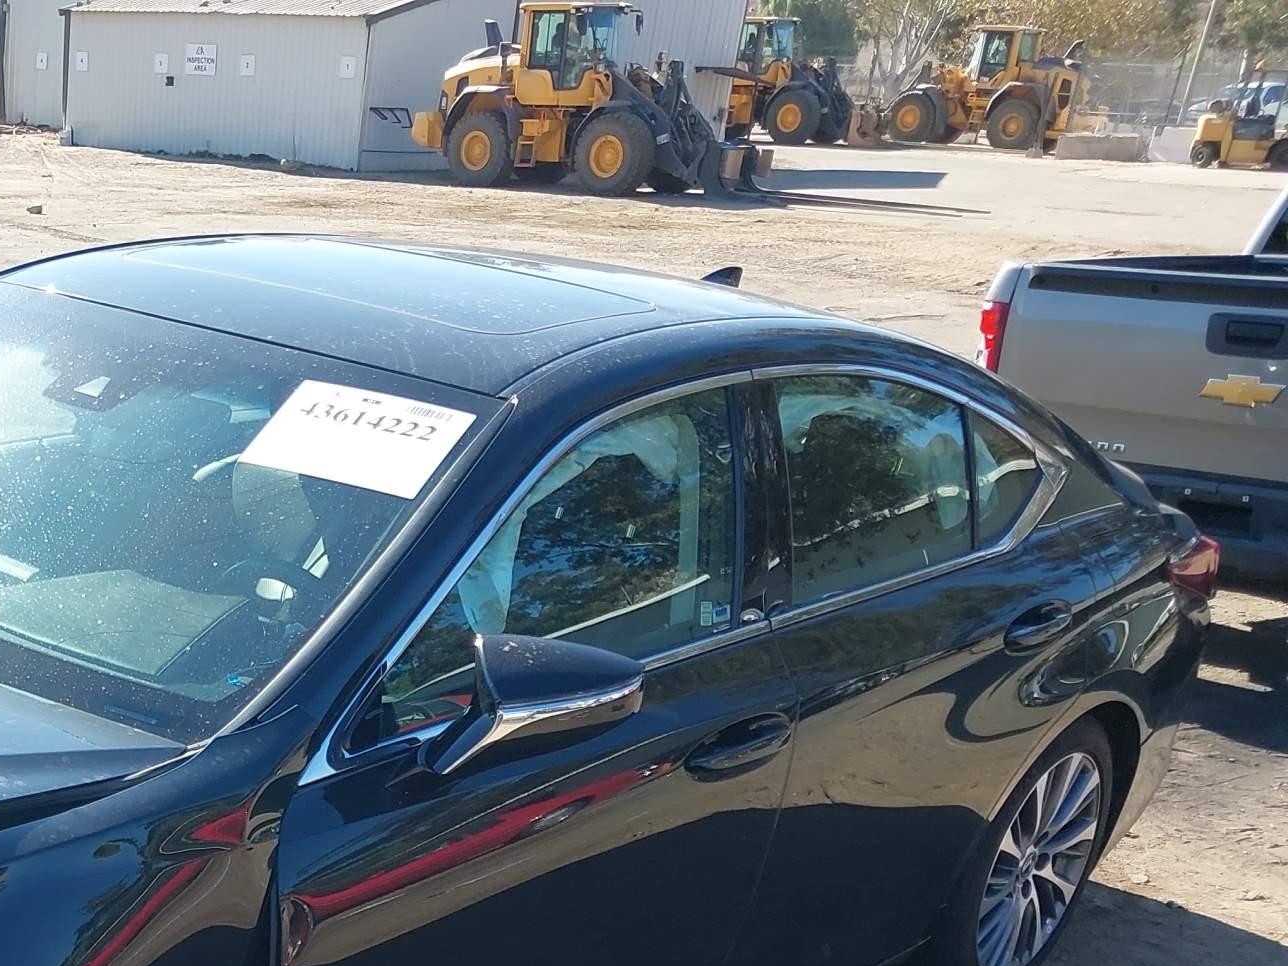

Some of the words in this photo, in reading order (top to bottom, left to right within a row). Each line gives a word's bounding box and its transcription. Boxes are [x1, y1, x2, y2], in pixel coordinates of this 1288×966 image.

[186, 57, 215, 65] INSPECTION
[194, 65, 208, 73] AREA
[300, 401, 439, 442] 43614222
